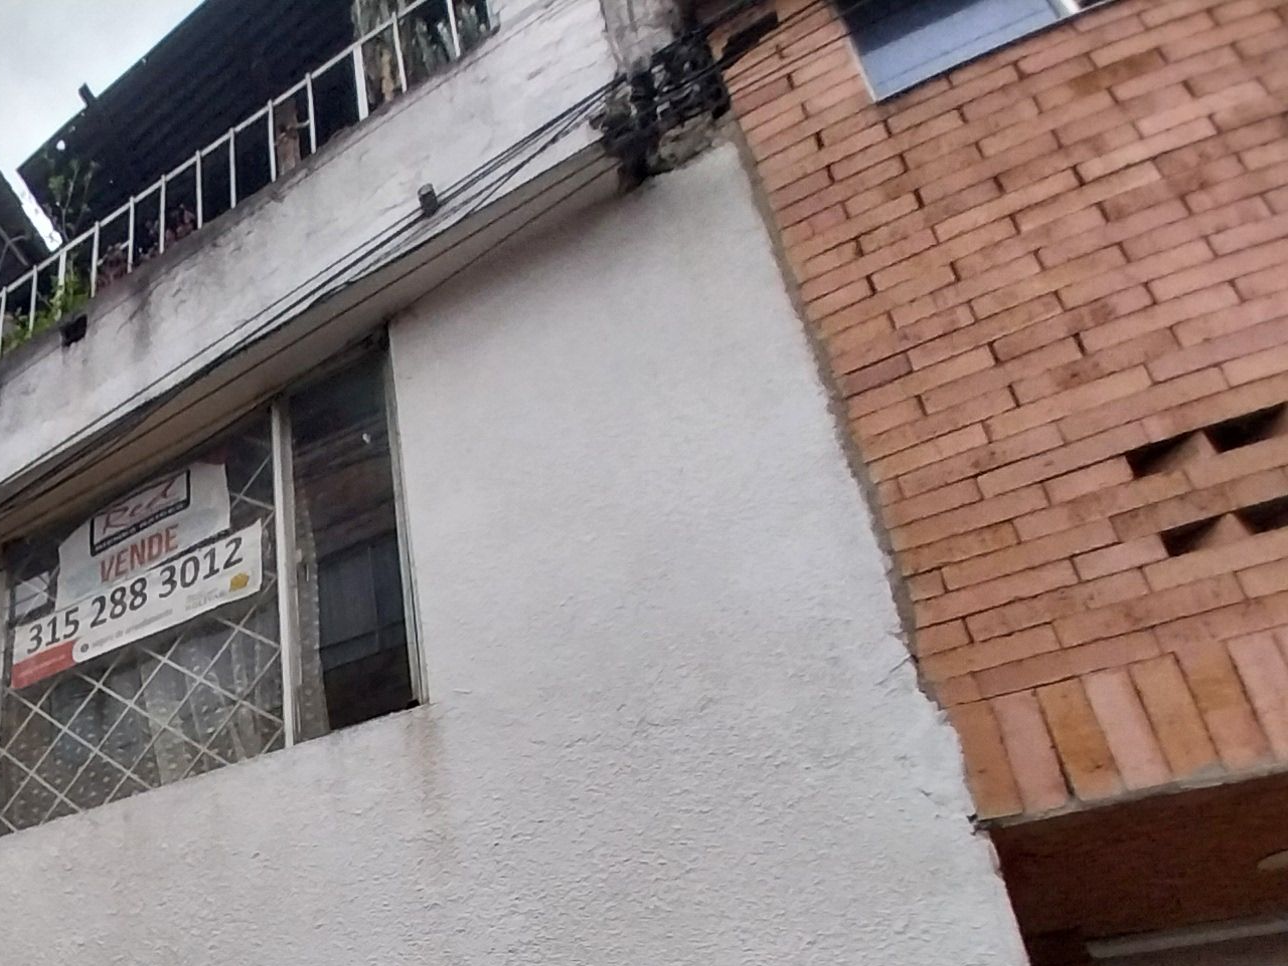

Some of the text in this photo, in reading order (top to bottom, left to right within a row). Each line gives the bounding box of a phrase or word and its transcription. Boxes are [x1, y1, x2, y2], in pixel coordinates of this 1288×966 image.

[27, 536, 243, 654] 315 288 3012
[100, 524, 179, 583] VENDE
